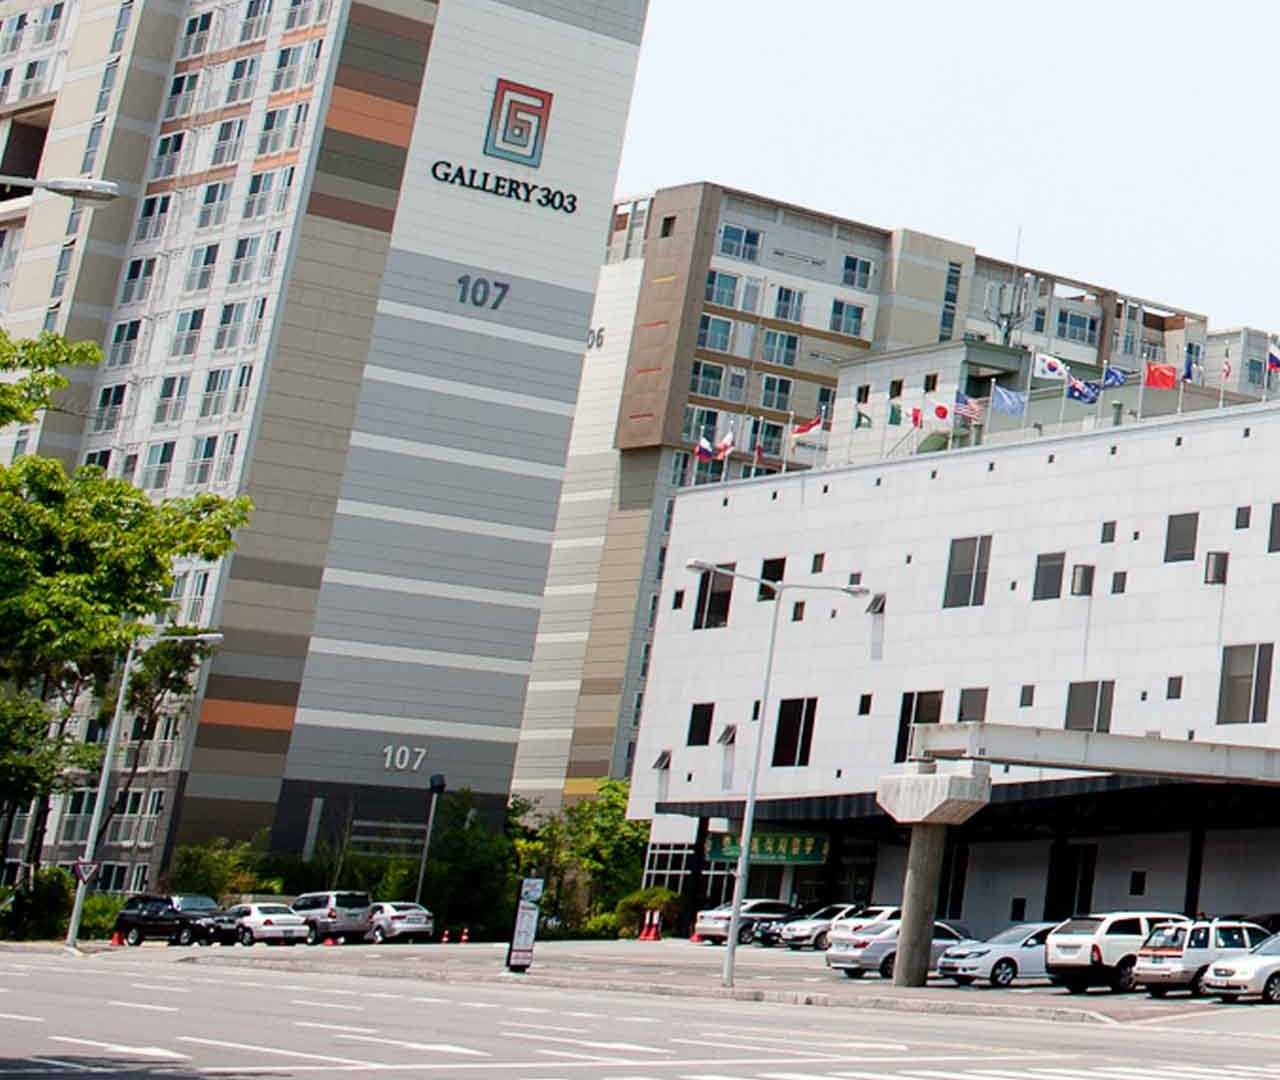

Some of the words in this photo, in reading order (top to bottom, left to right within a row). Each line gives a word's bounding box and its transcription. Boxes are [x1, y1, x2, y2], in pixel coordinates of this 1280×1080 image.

[430, 160, 538, 204] GALLERY
[536, 186, 578, 214] 303
[457, 274, 510, 310] 107
[587, 327, 605, 349] 06
[383, 745, 426, 770] 107
